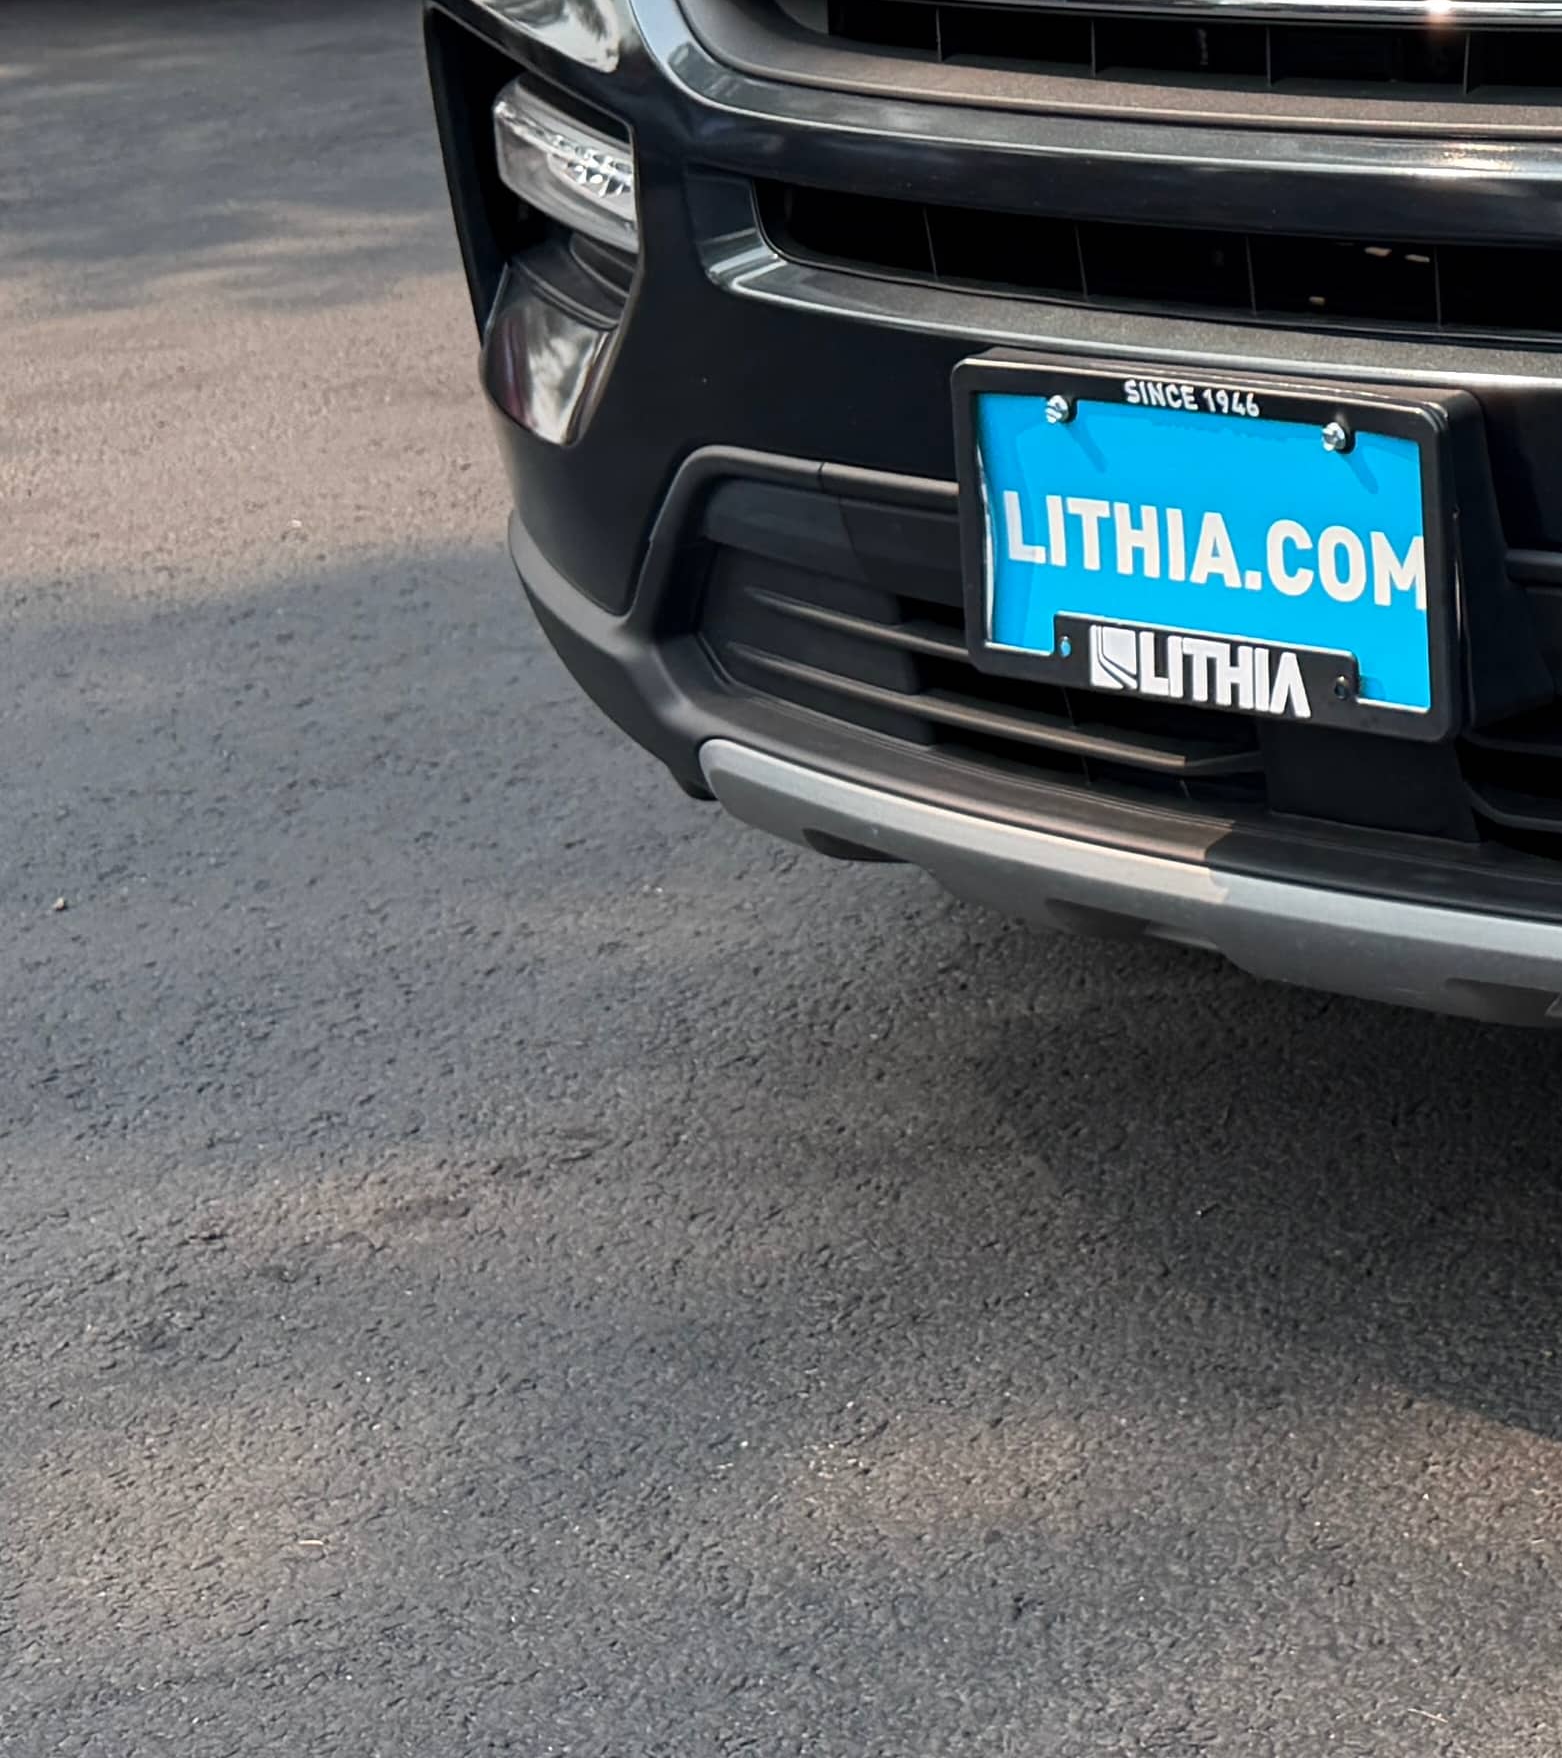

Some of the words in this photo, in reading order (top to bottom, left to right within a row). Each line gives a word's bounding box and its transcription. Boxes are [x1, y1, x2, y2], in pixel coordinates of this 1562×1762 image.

[1124, 379, 1199, 411] SINCE
[1203, 388, 1261, 418] 1946
[1003, 490, 1428, 611] LITHIA.COM
[1138, 631, 1312, 719] LITHIA
